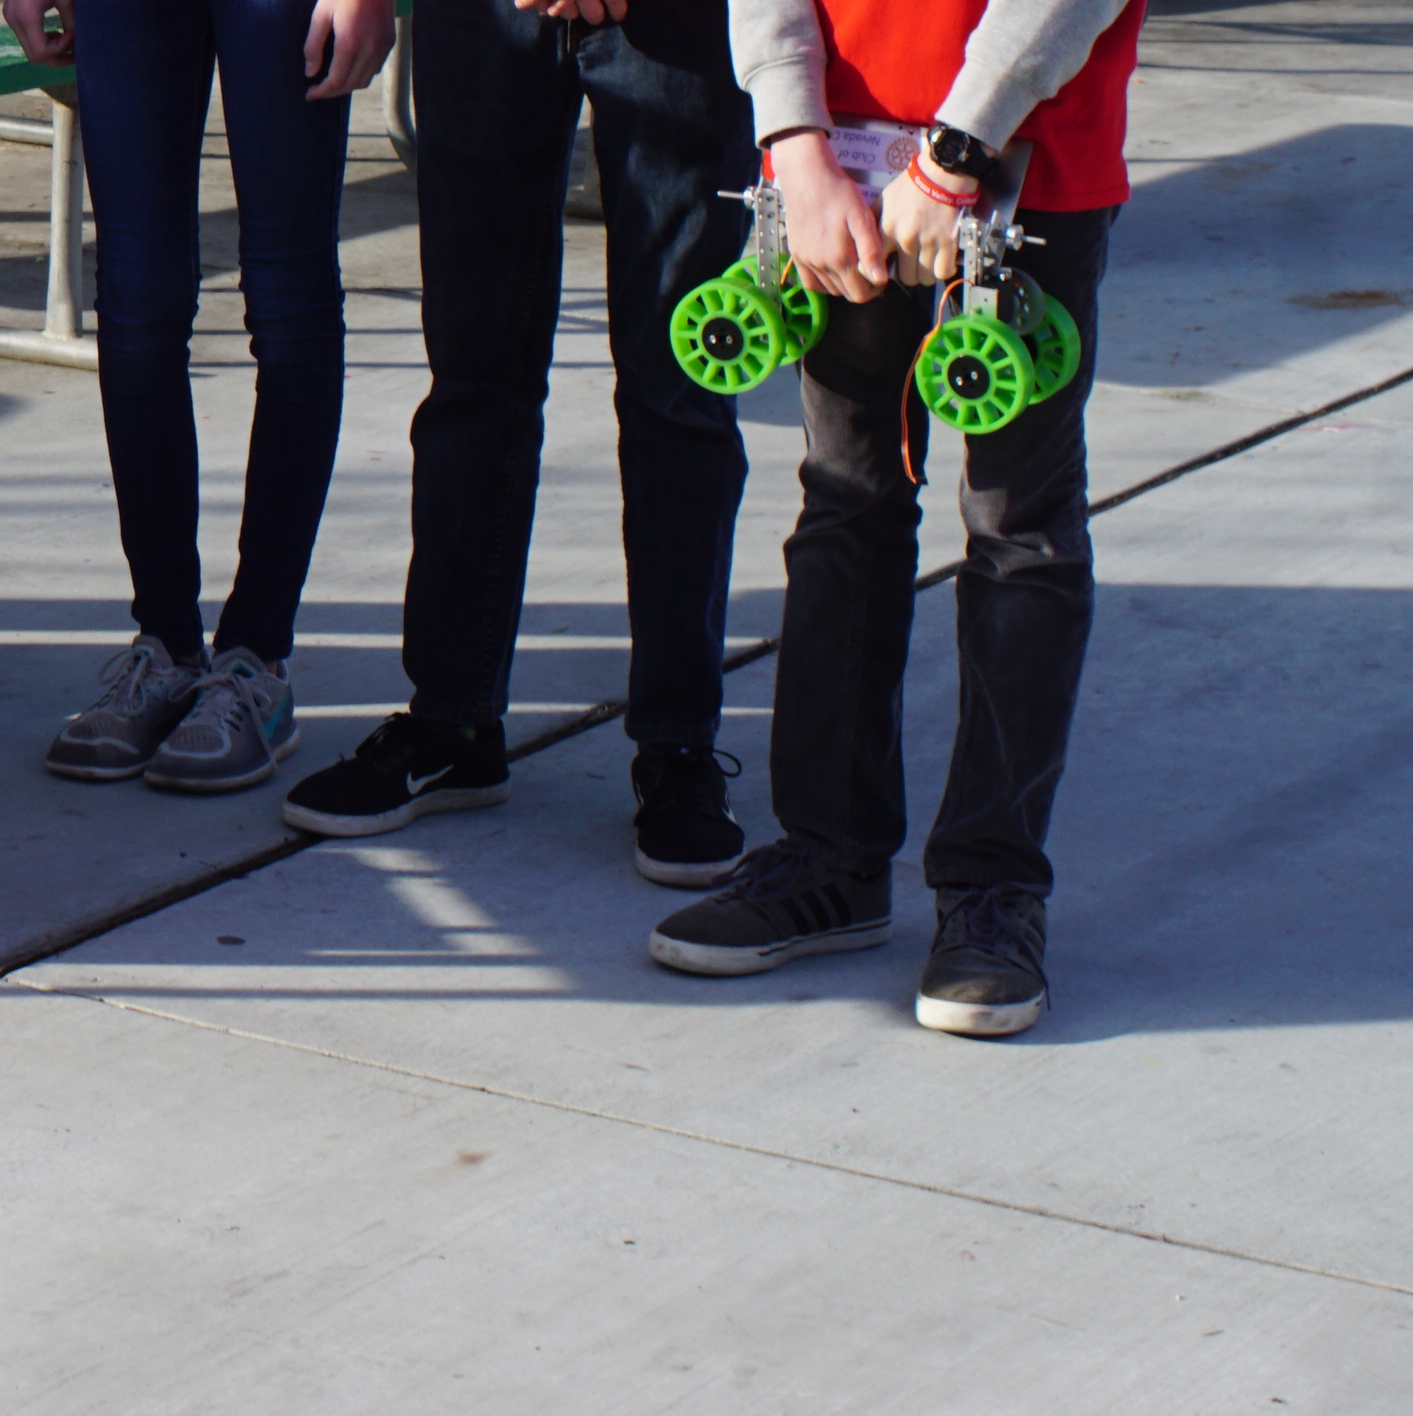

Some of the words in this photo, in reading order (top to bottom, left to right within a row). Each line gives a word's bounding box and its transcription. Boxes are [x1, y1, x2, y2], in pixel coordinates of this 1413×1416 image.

[843, 132, 881, 146] Nevada
[838, 150, 849, 159] of
[852, 151, 876, 163] Club
